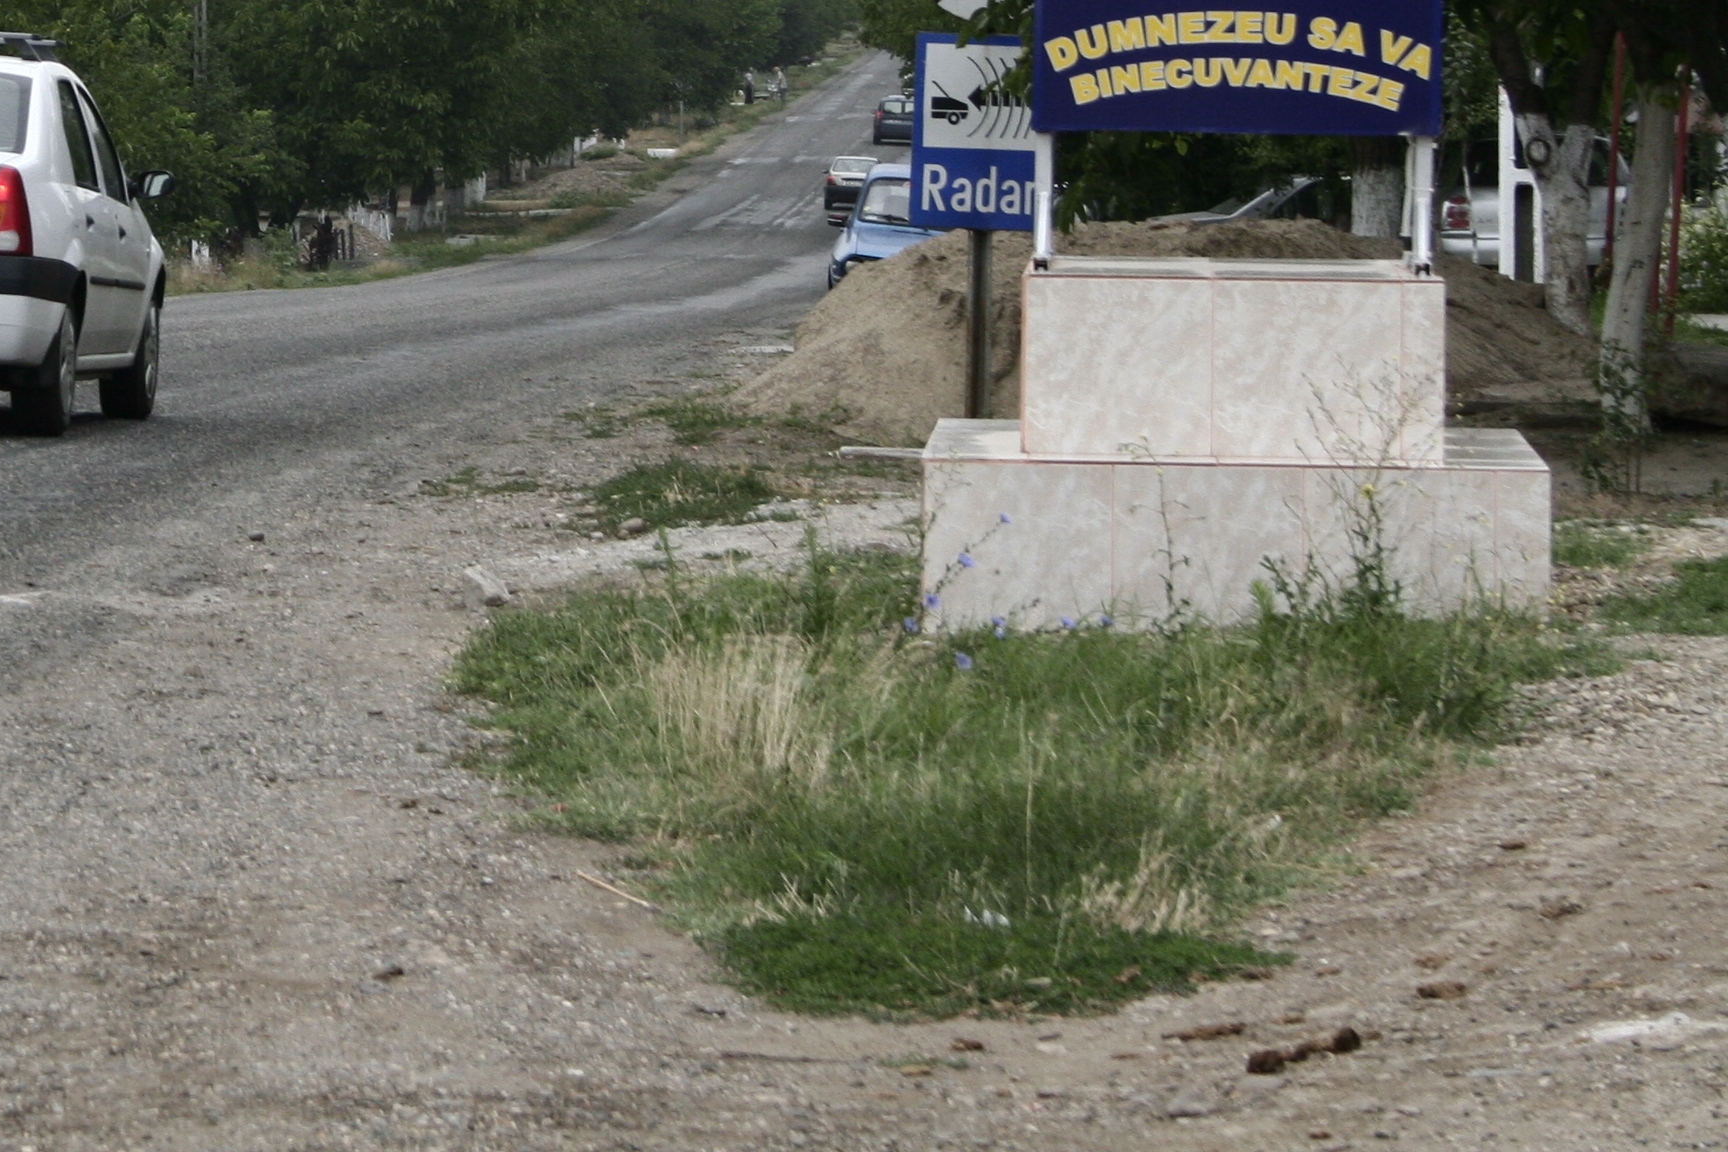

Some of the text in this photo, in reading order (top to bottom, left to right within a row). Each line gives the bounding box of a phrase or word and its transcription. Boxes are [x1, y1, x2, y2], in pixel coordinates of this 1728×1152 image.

[1043, 11, 1432, 81] DUMNEZEU SA VA
[1069, 58, 1405, 112] BINECUVANTEZE
[921, 163, 1036, 216] Radar
